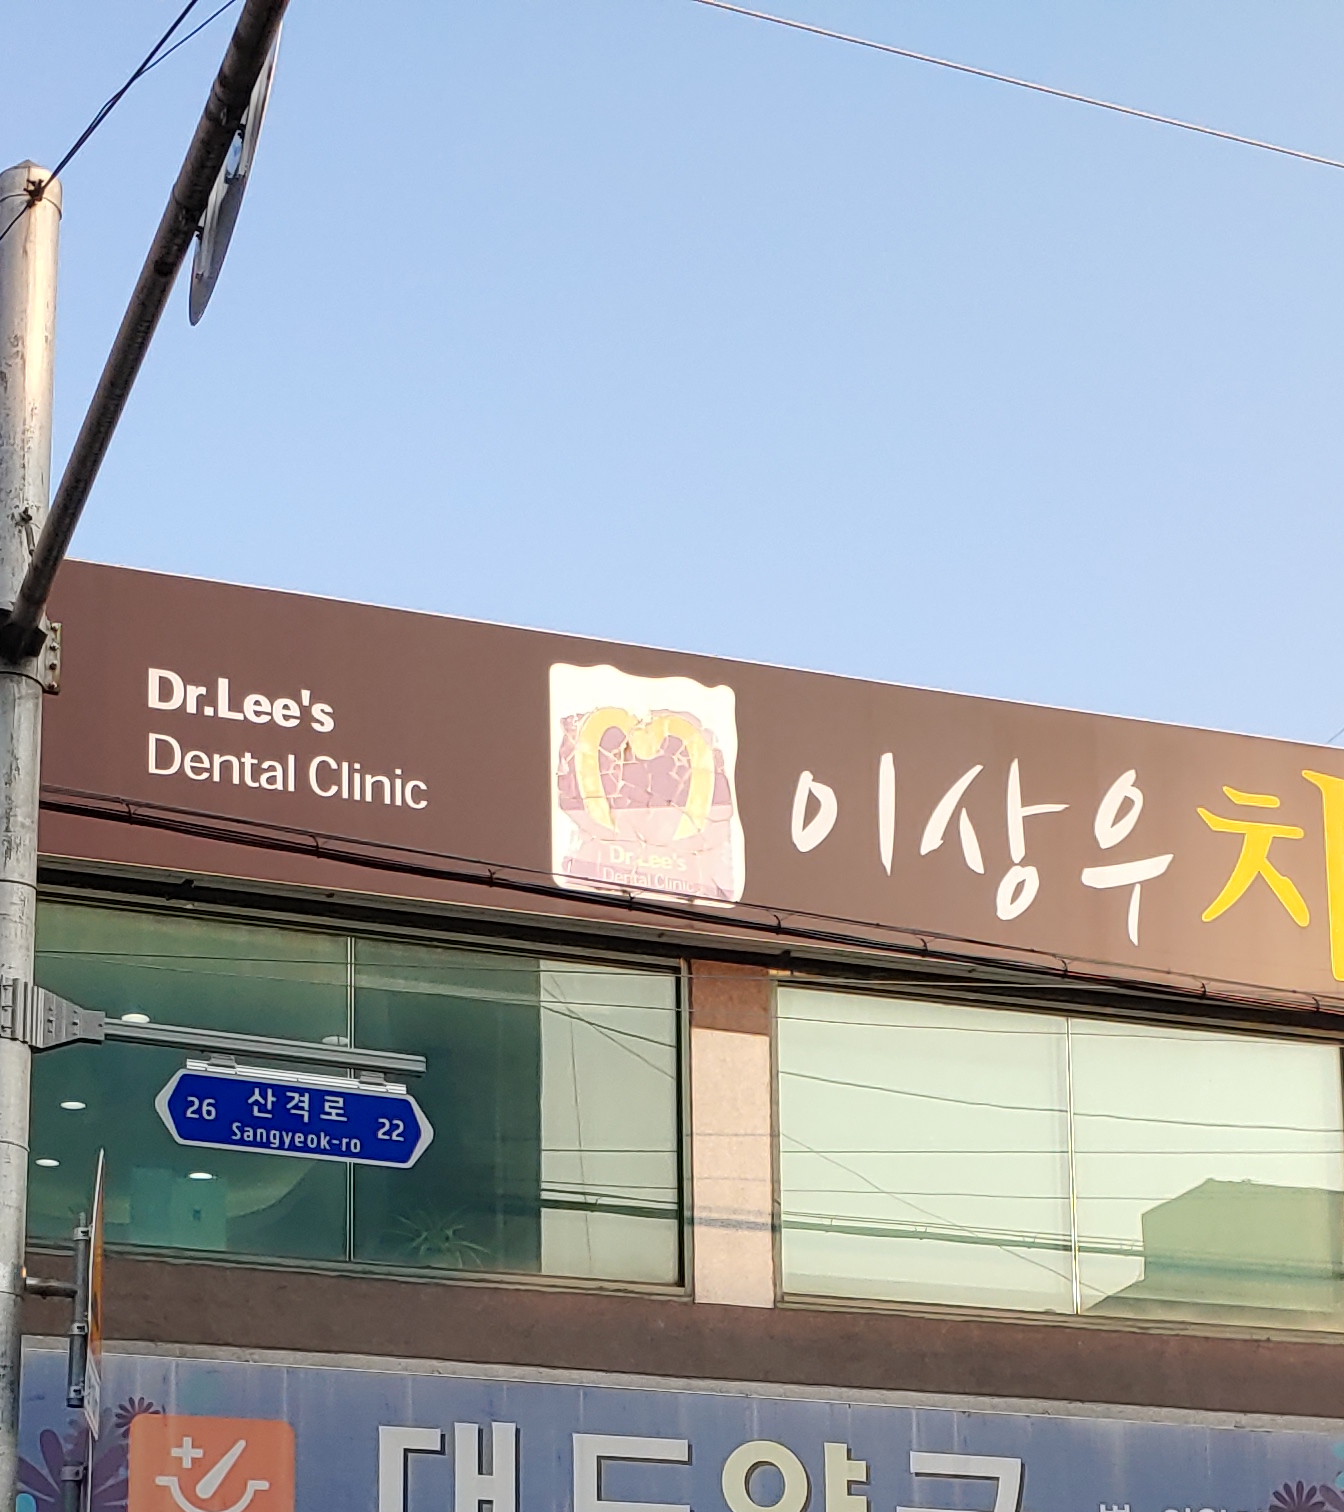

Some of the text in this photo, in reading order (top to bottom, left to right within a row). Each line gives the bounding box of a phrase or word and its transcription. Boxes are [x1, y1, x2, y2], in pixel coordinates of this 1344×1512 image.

[147, 667, 335, 732] Dr.Lee's
[147, 732, 429, 810] Dental Clinic
[791, 752, 1174, 946] 이상우
[603, 867, 695, 893] Dental Clinic
[185, 1086, 406, 1143] 26 산격로 22
[231, 1121, 362, 1155] Sangyeok-ro
